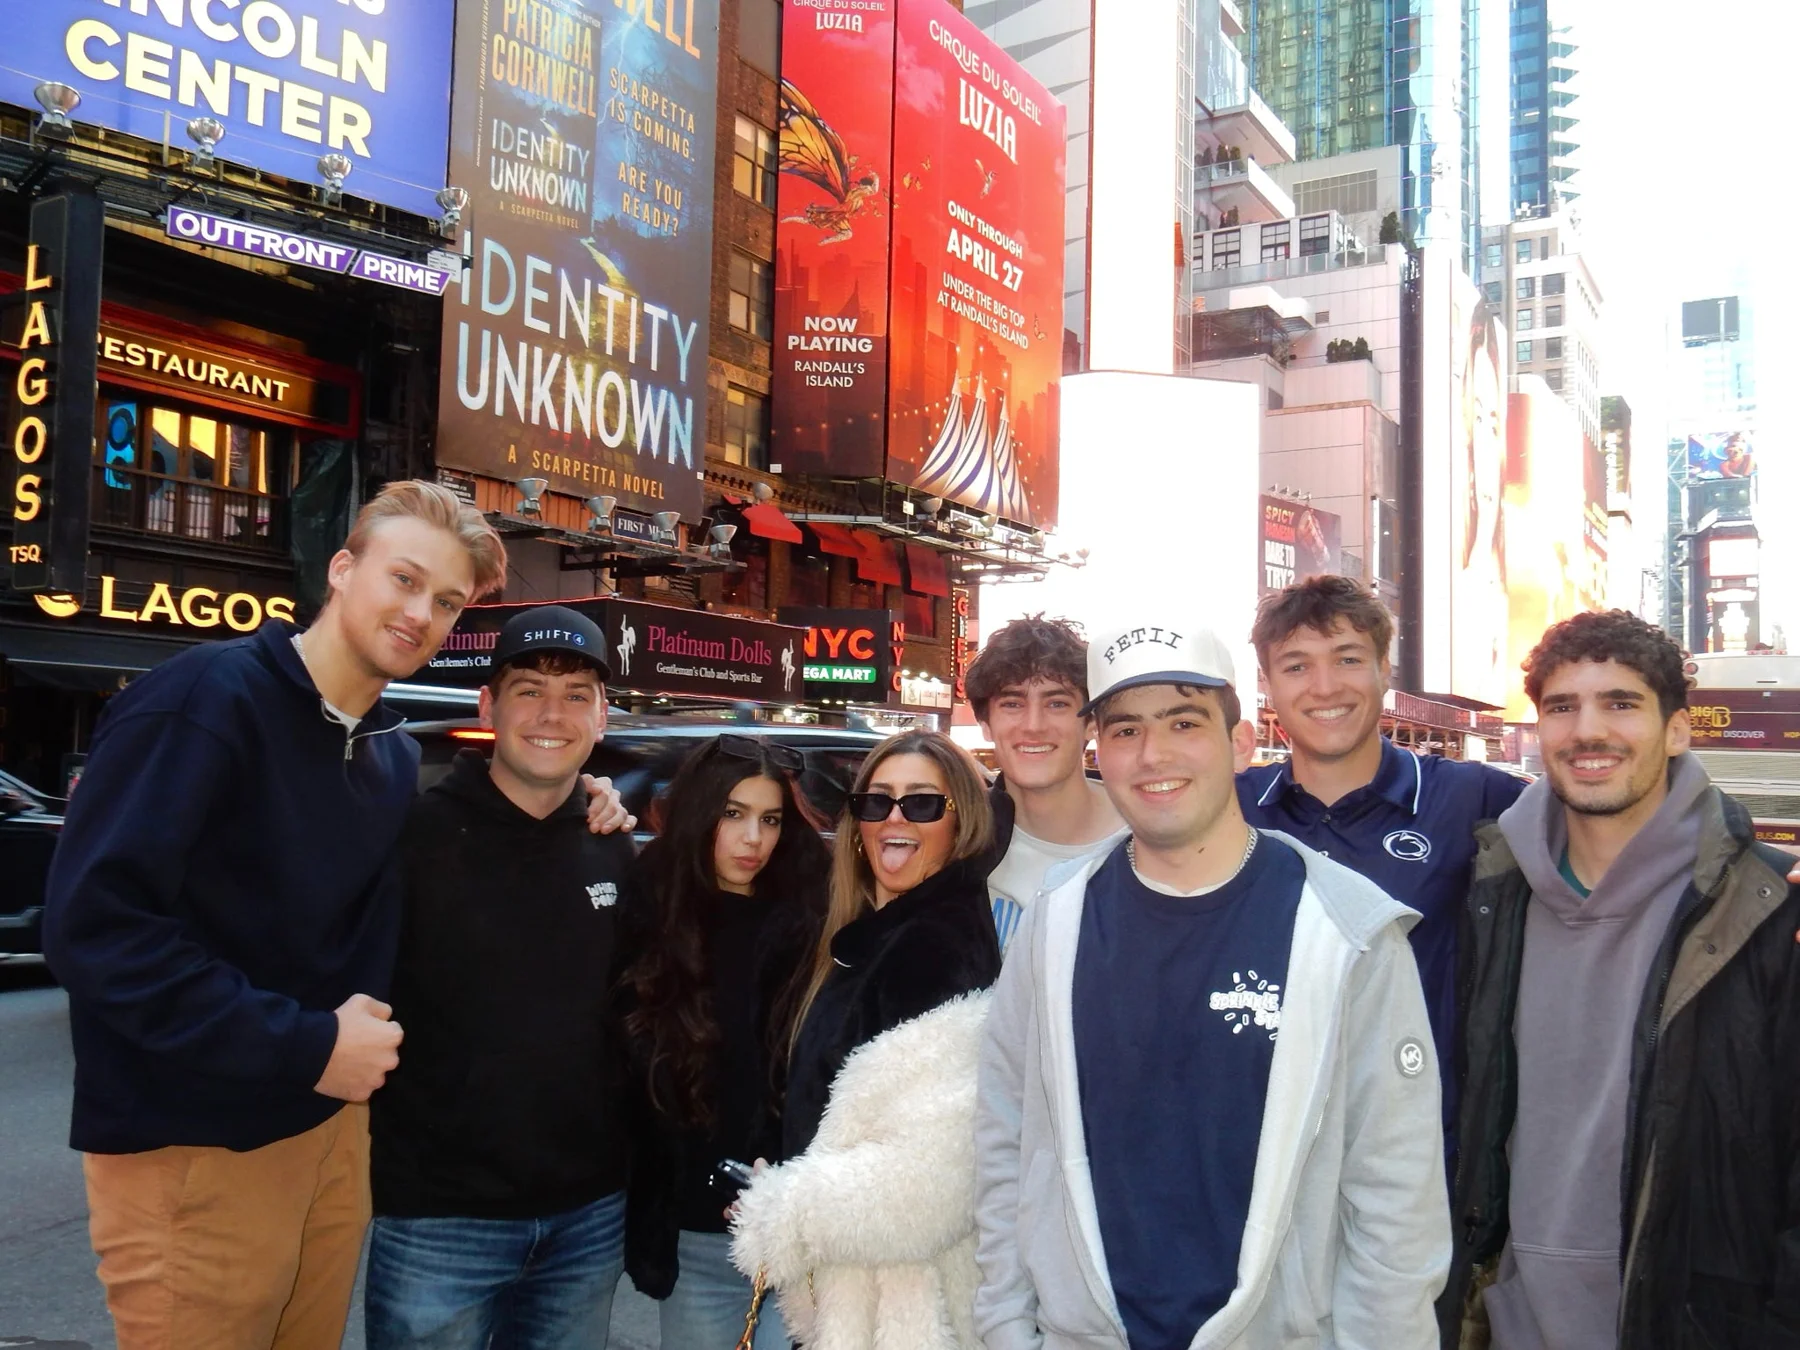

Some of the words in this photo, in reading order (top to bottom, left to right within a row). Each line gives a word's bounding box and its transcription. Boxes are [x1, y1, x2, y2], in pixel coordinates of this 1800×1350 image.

[816, 12, 863, 33] LUZIA
[834, 0, 849, 9] DU
[851, 1, 885, 11] SOLEIL
[104, 0, 388, 94] COLN
[503, 0, 592, 71] PATRICIA
[65, 19, 372, 159] CENTER
[492, 33, 597, 118] CORNWELL
[929, 19, 980, 74] CIRQUE
[982, 62, 1001, 90] DU
[1002, 80, 1042, 126] SOLEIL
[609, 67, 696, 134] SCARPETTA
[959, 77, 1018, 165] LUZIA
[492, 118, 590, 177] IDENTITY
[609, 98, 626, 124] IS
[633, 109, 696, 162] COMING.
[490, 156, 587, 214] UNKNOWN
[618, 161, 648, 193] ARE
[655, 178, 682, 211] YOU
[511, 203, 554, 223] SCARPETTA
[557, 214, 579, 229] NOVEL
[622, 193, 679, 237] READY?
[948, 200, 976, 227] ONLY
[977, 213, 1023, 260] THROUGH
[175, 213, 346, 271] OUTFRONT
[364, 255, 441, 293] PRIME
[947, 228, 1000, 281] APRIL
[1002, 260, 1024, 292] 27
[461, 229, 698, 383] IDENTITY
[804, 316, 858, 333] NOW
[937, 290, 949, 305] AT
[951, 296, 998, 333] RANDALL'S
[999, 320, 1029, 350] ISLAND
[943, 271, 975, 302] UNDER
[976, 283, 992, 309] THE
[993, 294, 1008, 318] BIG
[1009, 304, 1025, 329] TOP
[787, 335, 873, 353] PLAYING
[794, 360, 865, 374] RANDALL'S
[14, 244, 53, 521] LAGOS
[457, 322, 694, 471] UNKNOWN
[805, 375, 853, 388] ISLAND
[508, 444, 517, 464] A
[532, 450, 617, 488] SCARPETTA
[623, 473, 665, 500] NOVEL
[618, 518, 644, 534] FIRST
[1265, 506, 1295, 525] SPICY
[1265, 565, 1296, 590] TRY?
[1285, 545, 1296, 569] TO
[101, 577, 296, 632] LAGOS
[647, 625, 726, 660] Platinum
[730, 637, 772, 666] Dolls
[804, 628, 875, 660] NYC
[893, 621, 905, 692] NYC
[956, 596, 969, 699] GIFTS
[1103, 627, 1183, 665] FETII
[699, 668, 716, 679] Club
[716, 670, 729, 681] and
[729, 670, 751, 683] Sports
[751, 673, 764, 684] Bar
[832, 668, 871, 681] MART
[1690, 706, 1711, 717] BIG
[1690, 717, 1711, 728] BUS
[1723, 730, 1765, 738] DISCOVER
